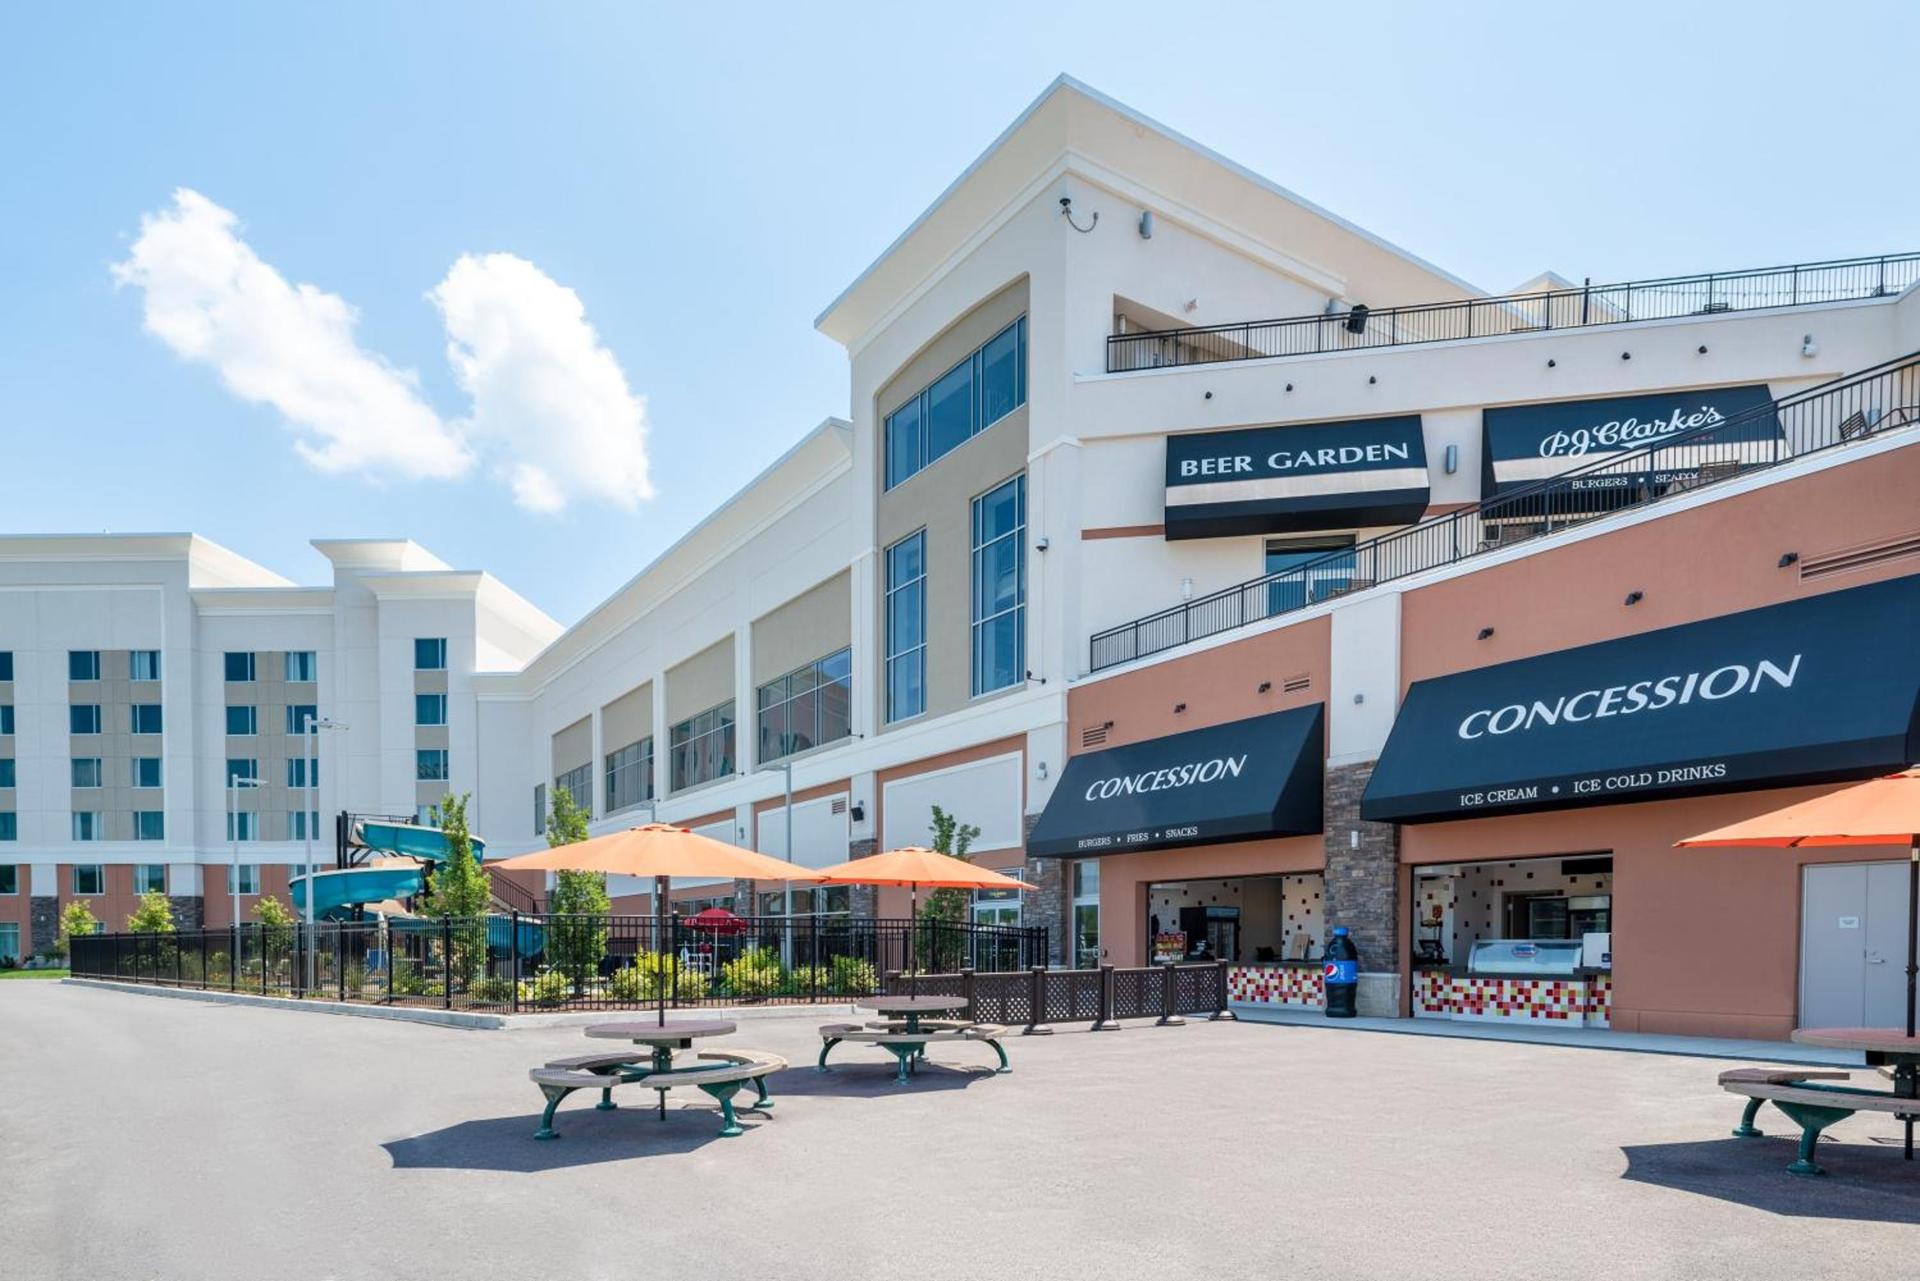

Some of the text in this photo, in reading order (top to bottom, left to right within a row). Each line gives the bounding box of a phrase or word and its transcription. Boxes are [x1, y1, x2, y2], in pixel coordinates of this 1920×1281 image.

[1593, 406, 1726, 446] Clarke's
[1181, 443, 1409, 477] BEER GARDEN
[1571, 471, 1712, 489] BURGERS SEAFO
[1457, 653, 1802, 741] CONCESSION
[1085, 754, 1248, 802] CONCESSION
[1460, 763, 1727, 807] ICE CREAM ICE COLD DRINKS
[1078, 826, 1198, 849] BURGERS FRIES SNACKS
